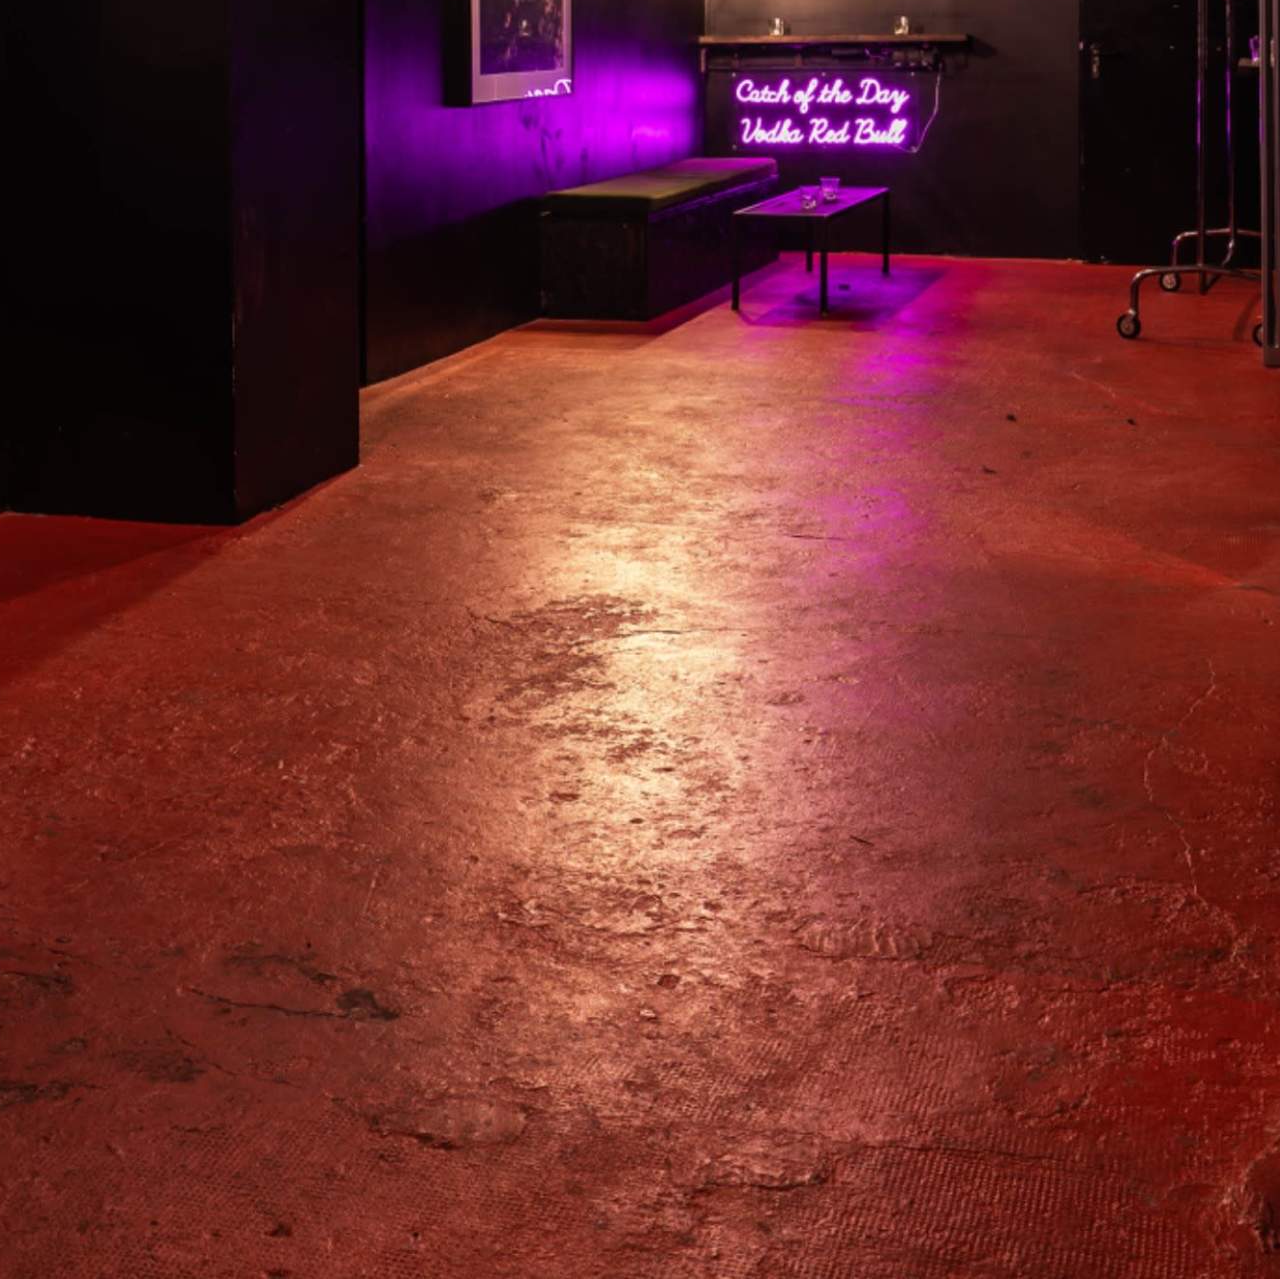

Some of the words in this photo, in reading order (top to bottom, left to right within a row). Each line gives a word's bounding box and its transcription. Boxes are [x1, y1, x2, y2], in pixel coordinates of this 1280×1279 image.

[736, 79, 791, 103] Catch
[793, 78, 819, 113] of
[817, 79, 853, 103] the
[855, 78, 909, 113] Day
[740, 117, 803, 143] Vodka
[808, 118, 851, 143] Red
[854, 118, 907, 143] Bull
